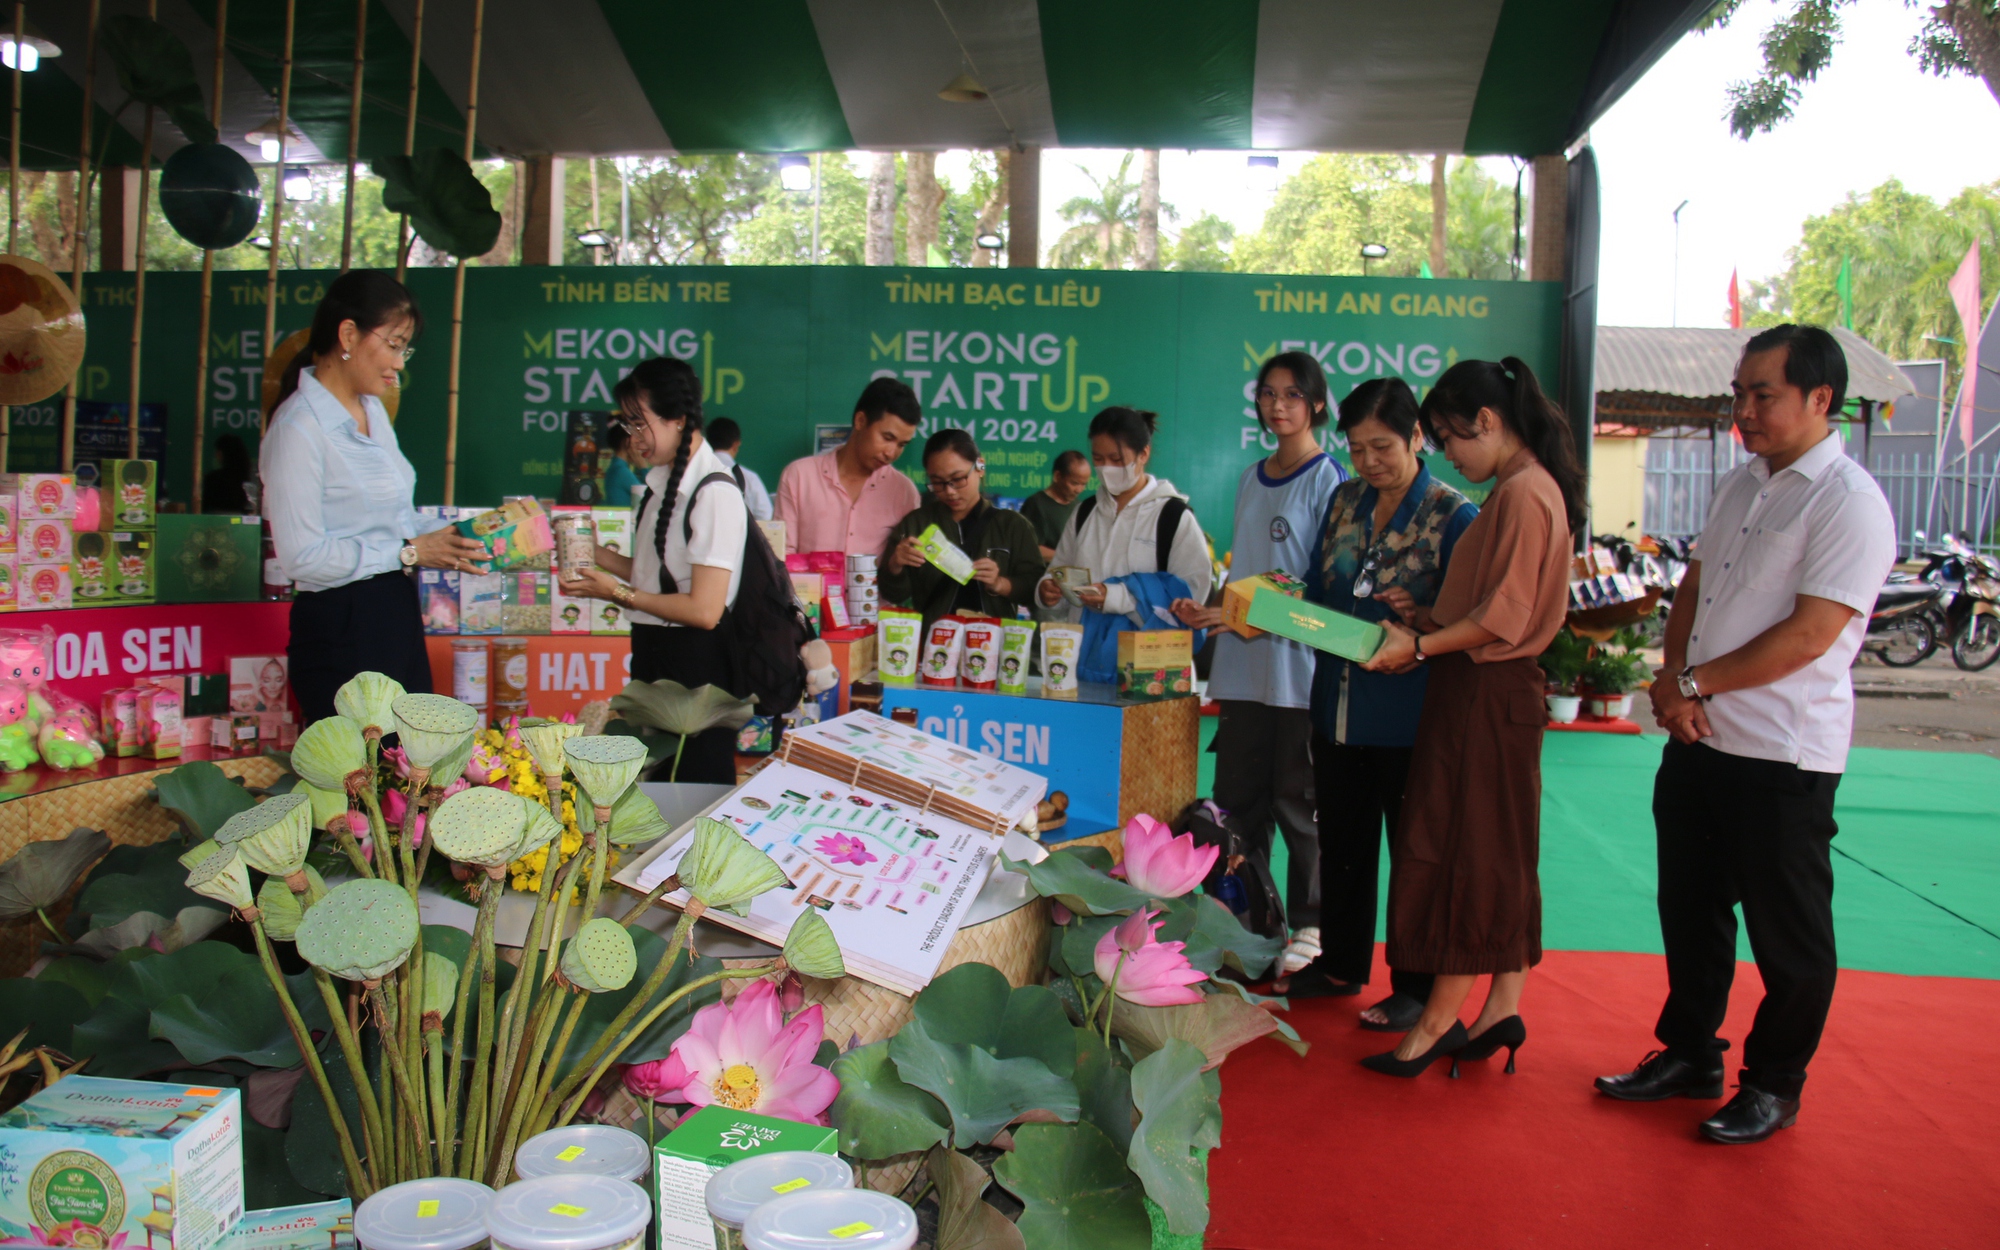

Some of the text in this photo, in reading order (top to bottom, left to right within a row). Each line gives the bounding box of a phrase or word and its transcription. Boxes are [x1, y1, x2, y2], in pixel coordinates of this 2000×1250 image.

[541, 274, 731, 303] TỈNH BẾN TRE
[885, 275, 1101, 311] TỈNH BẠC LIÊU
[1254, 282, 1489, 318] TỈNH AN GIANG
[523, 328, 699, 360] MEKONG
[870, 331, 1061, 366] MEKONG
[982, 418, 1058, 443] 2024
[121, 625, 202, 673] SEN
[539, 653, 611, 699] HẠT
[980, 720, 1050, 766] SEN
[920, 943, 933, 954] THE
[939, 902, 957, 923] DIAGRAM
[65, 1092, 181, 1109] DothaLotus
[186, 1121, 231, 1160] DothaLotus
[751, 1132, 778, 1141] SEN
